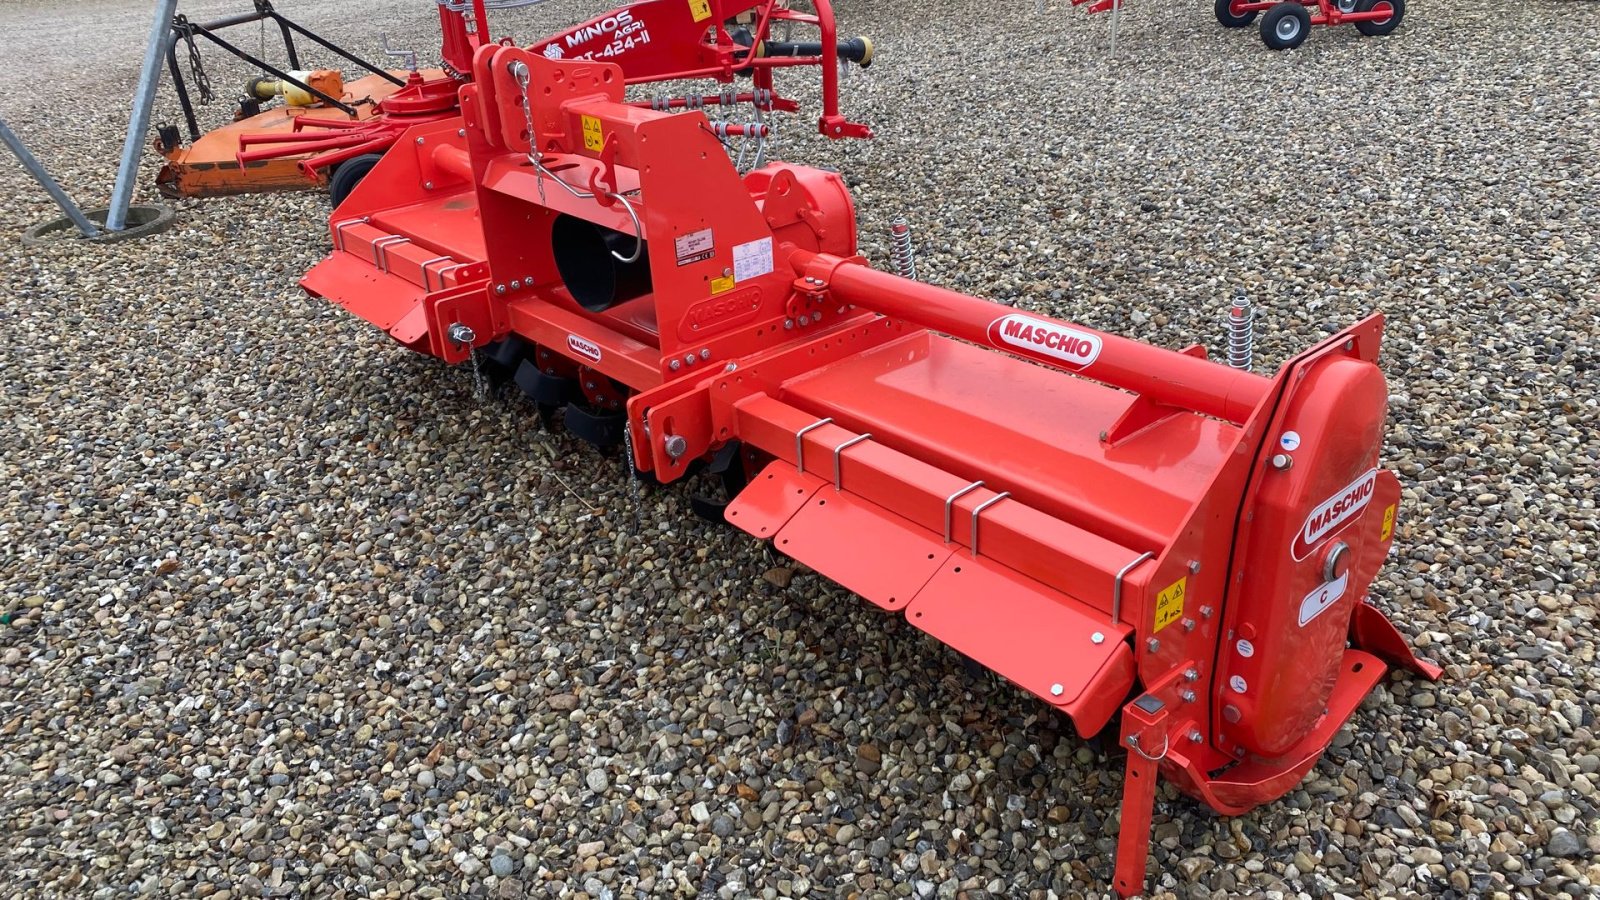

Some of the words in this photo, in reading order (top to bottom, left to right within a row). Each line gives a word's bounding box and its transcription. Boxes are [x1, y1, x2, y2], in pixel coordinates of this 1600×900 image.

[570, 338, 599, 357] MASCHIO
[1004, 319, 1093, 358] MASCHIO
[1308, 477, 1373, 538] MASCHIO
[1319, 589, 1328, 604] C
